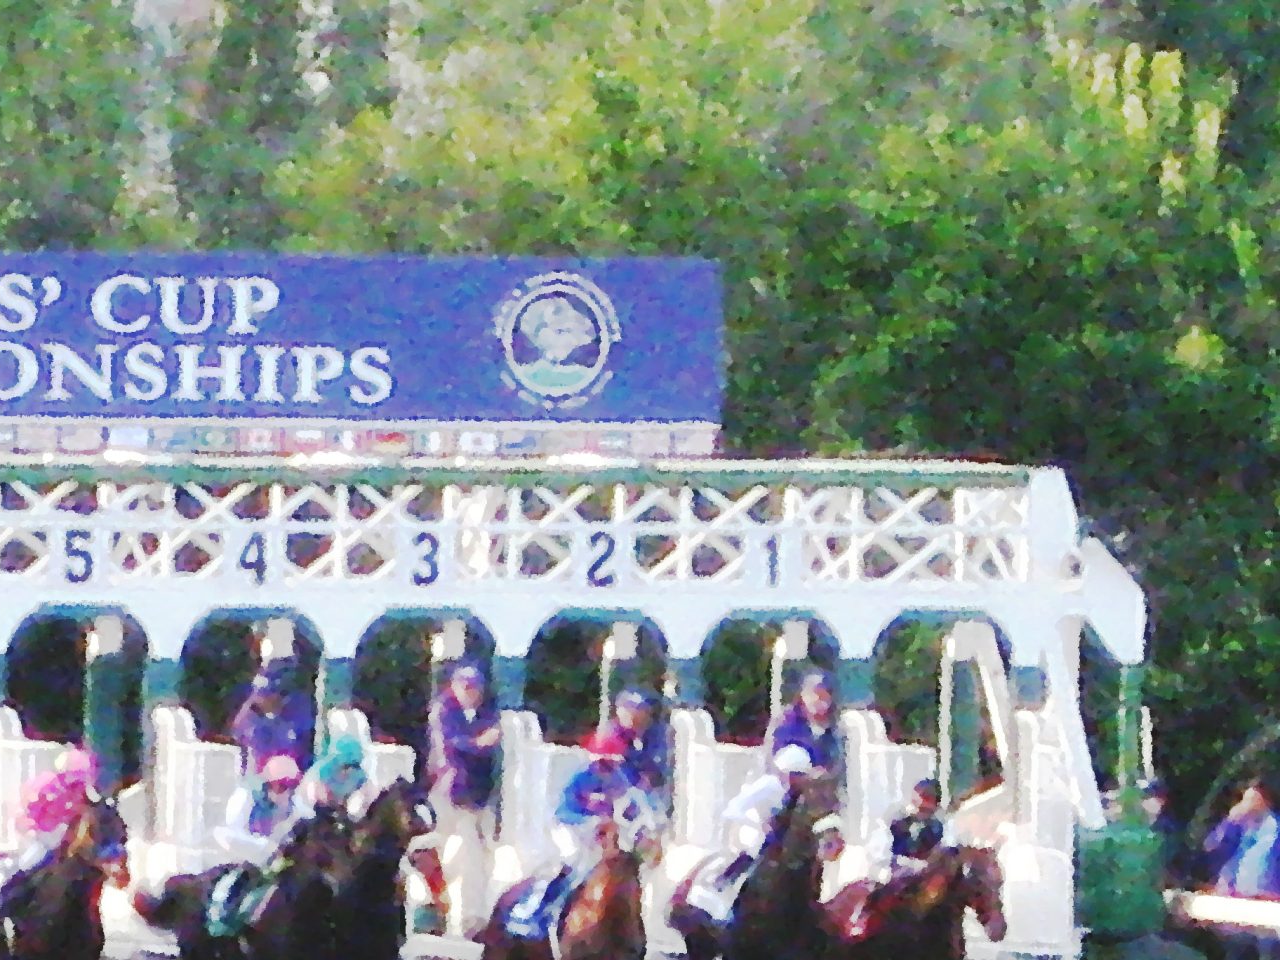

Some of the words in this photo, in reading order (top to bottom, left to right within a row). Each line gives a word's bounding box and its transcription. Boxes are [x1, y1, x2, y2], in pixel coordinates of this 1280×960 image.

[91, 273, 280, 336] CUP
[65, 529, 93, 583] 5
[238, 531, 267, 585] 4
[412, 531, 439, 586] 3
[586, 531, 616, 587] 2
[765, 533, 778, 586] 1
